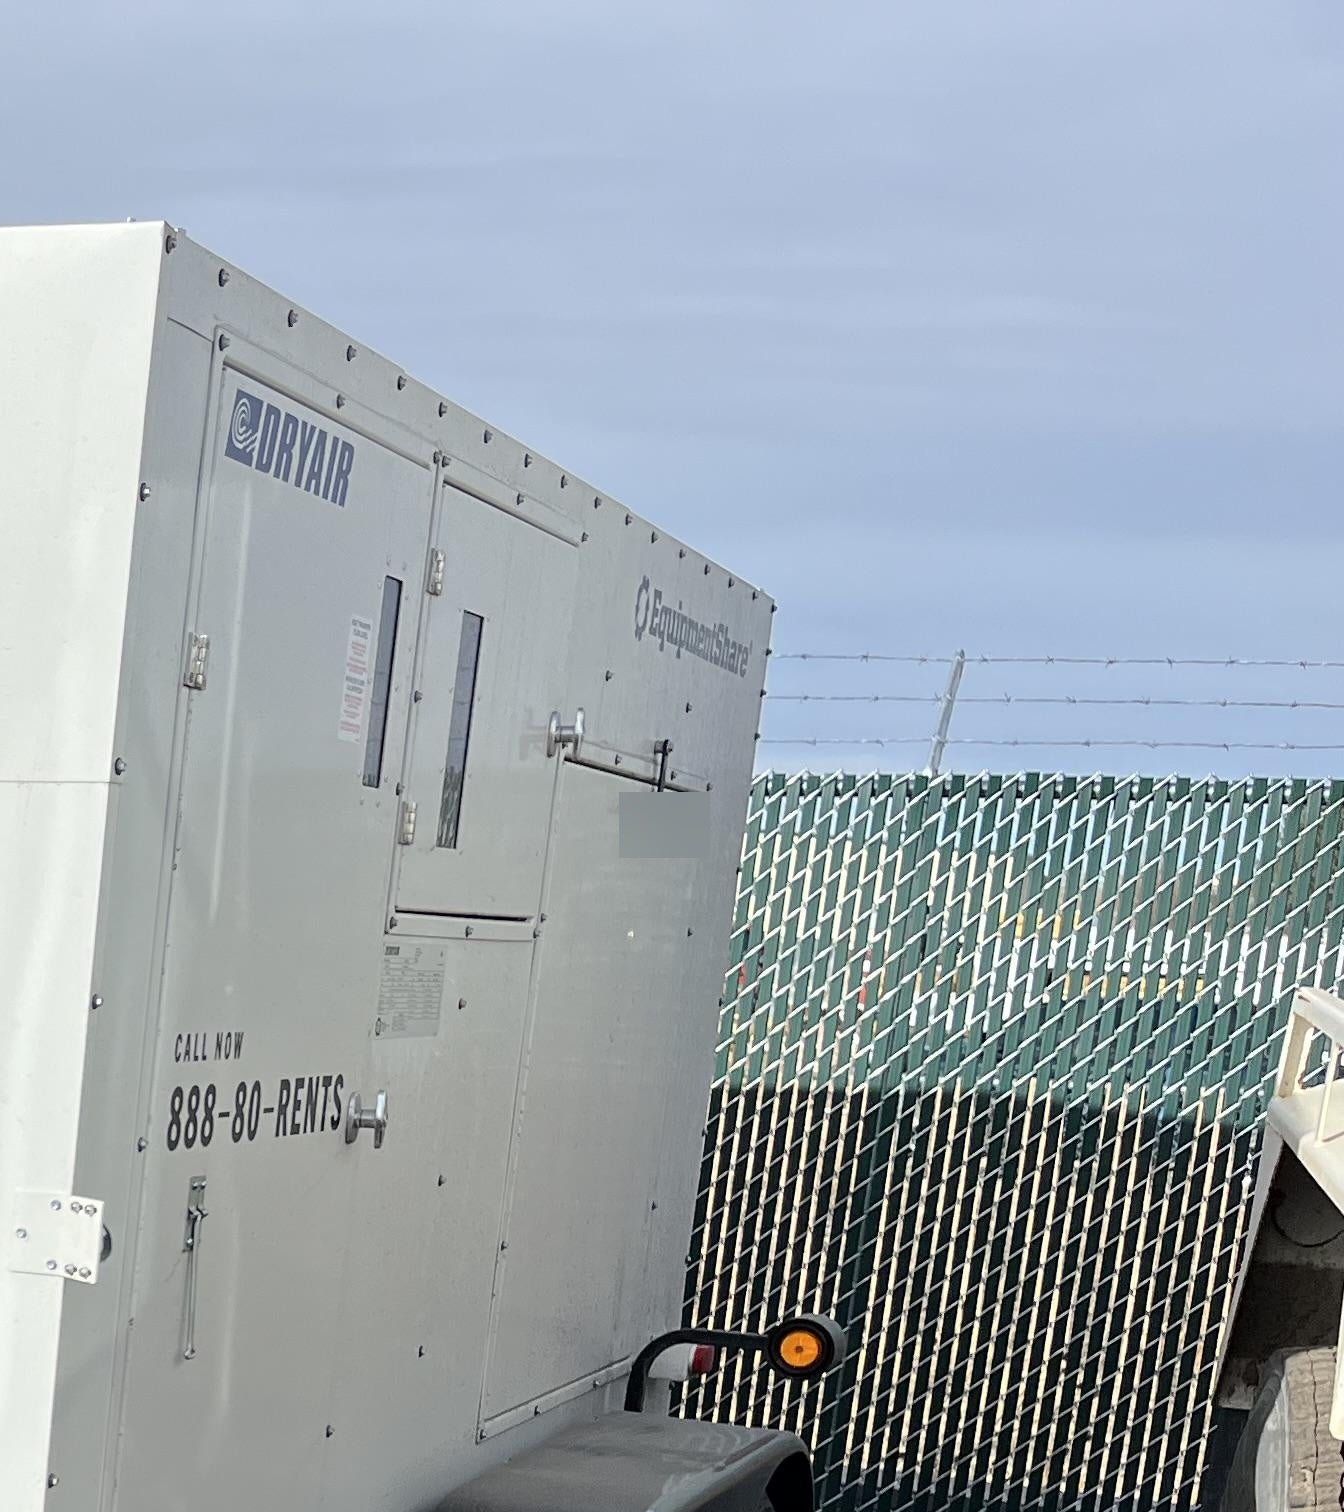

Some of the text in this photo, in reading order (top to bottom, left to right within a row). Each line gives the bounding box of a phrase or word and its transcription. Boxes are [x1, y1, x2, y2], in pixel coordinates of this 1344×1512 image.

[255, 402, 355, 508] DRYAIR
[649, 588, 749, 678] EquipmentShare
[174, 1031, 244, 1063] CALL NOW
[167, 1073, 344, 1152] 888-80-RENTS
